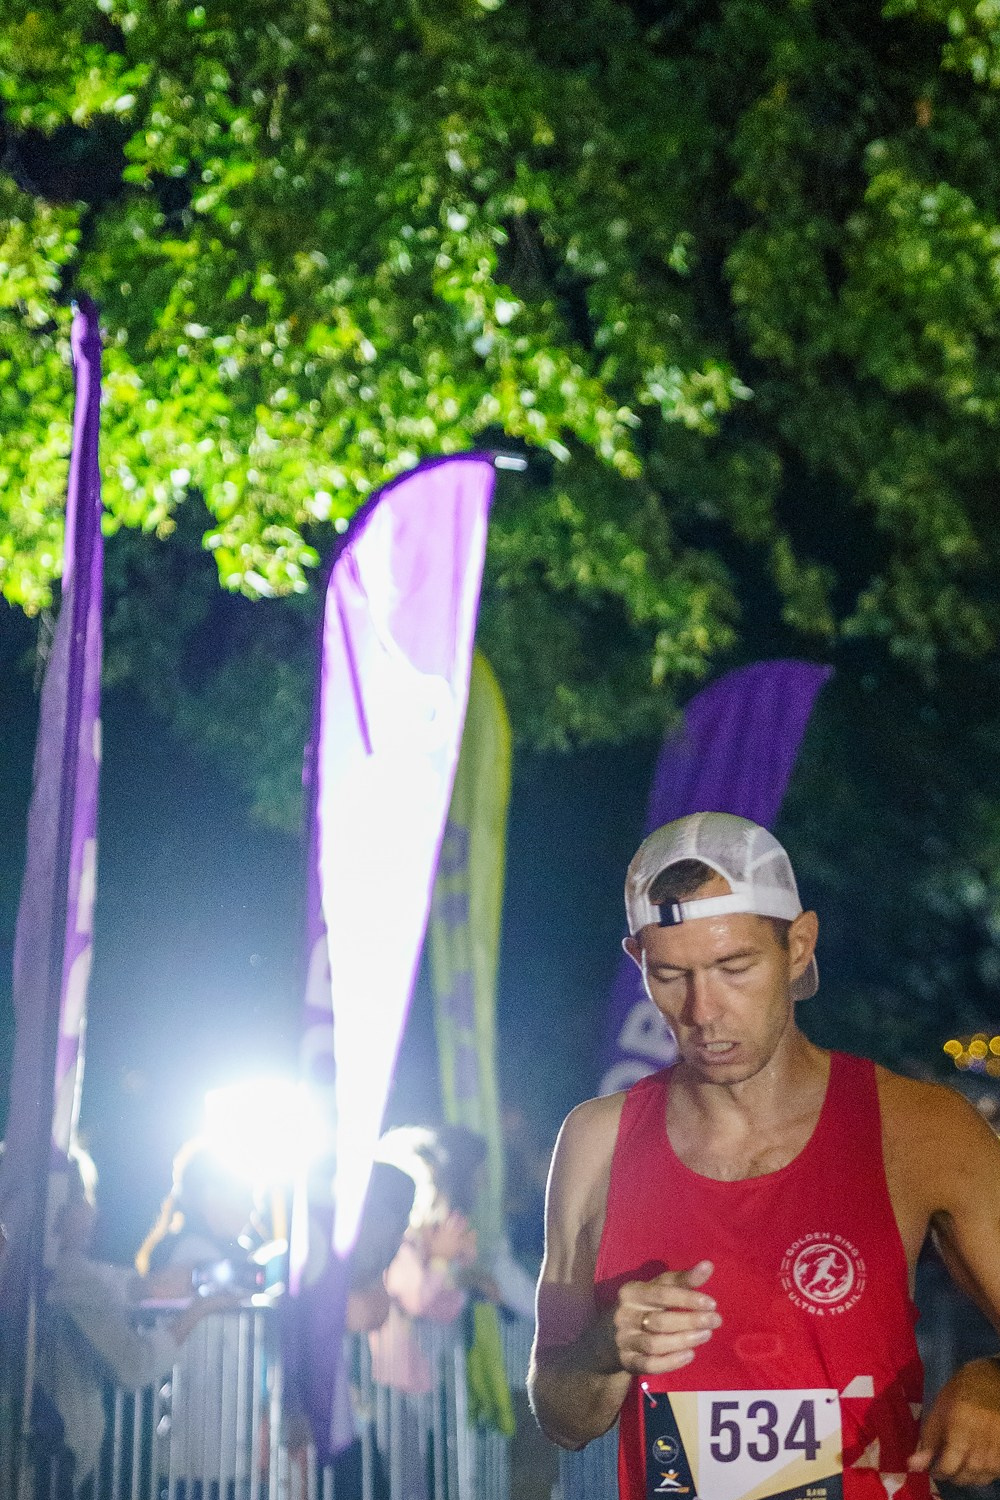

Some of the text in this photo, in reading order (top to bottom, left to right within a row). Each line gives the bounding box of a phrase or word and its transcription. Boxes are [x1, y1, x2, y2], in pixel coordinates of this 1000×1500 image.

[785, 1232, 859, 1257] GOLDEN RING
[788, 1291, 862, 1316] ULTRA TRAIL
[709, 1399, 821, 1463] 534
